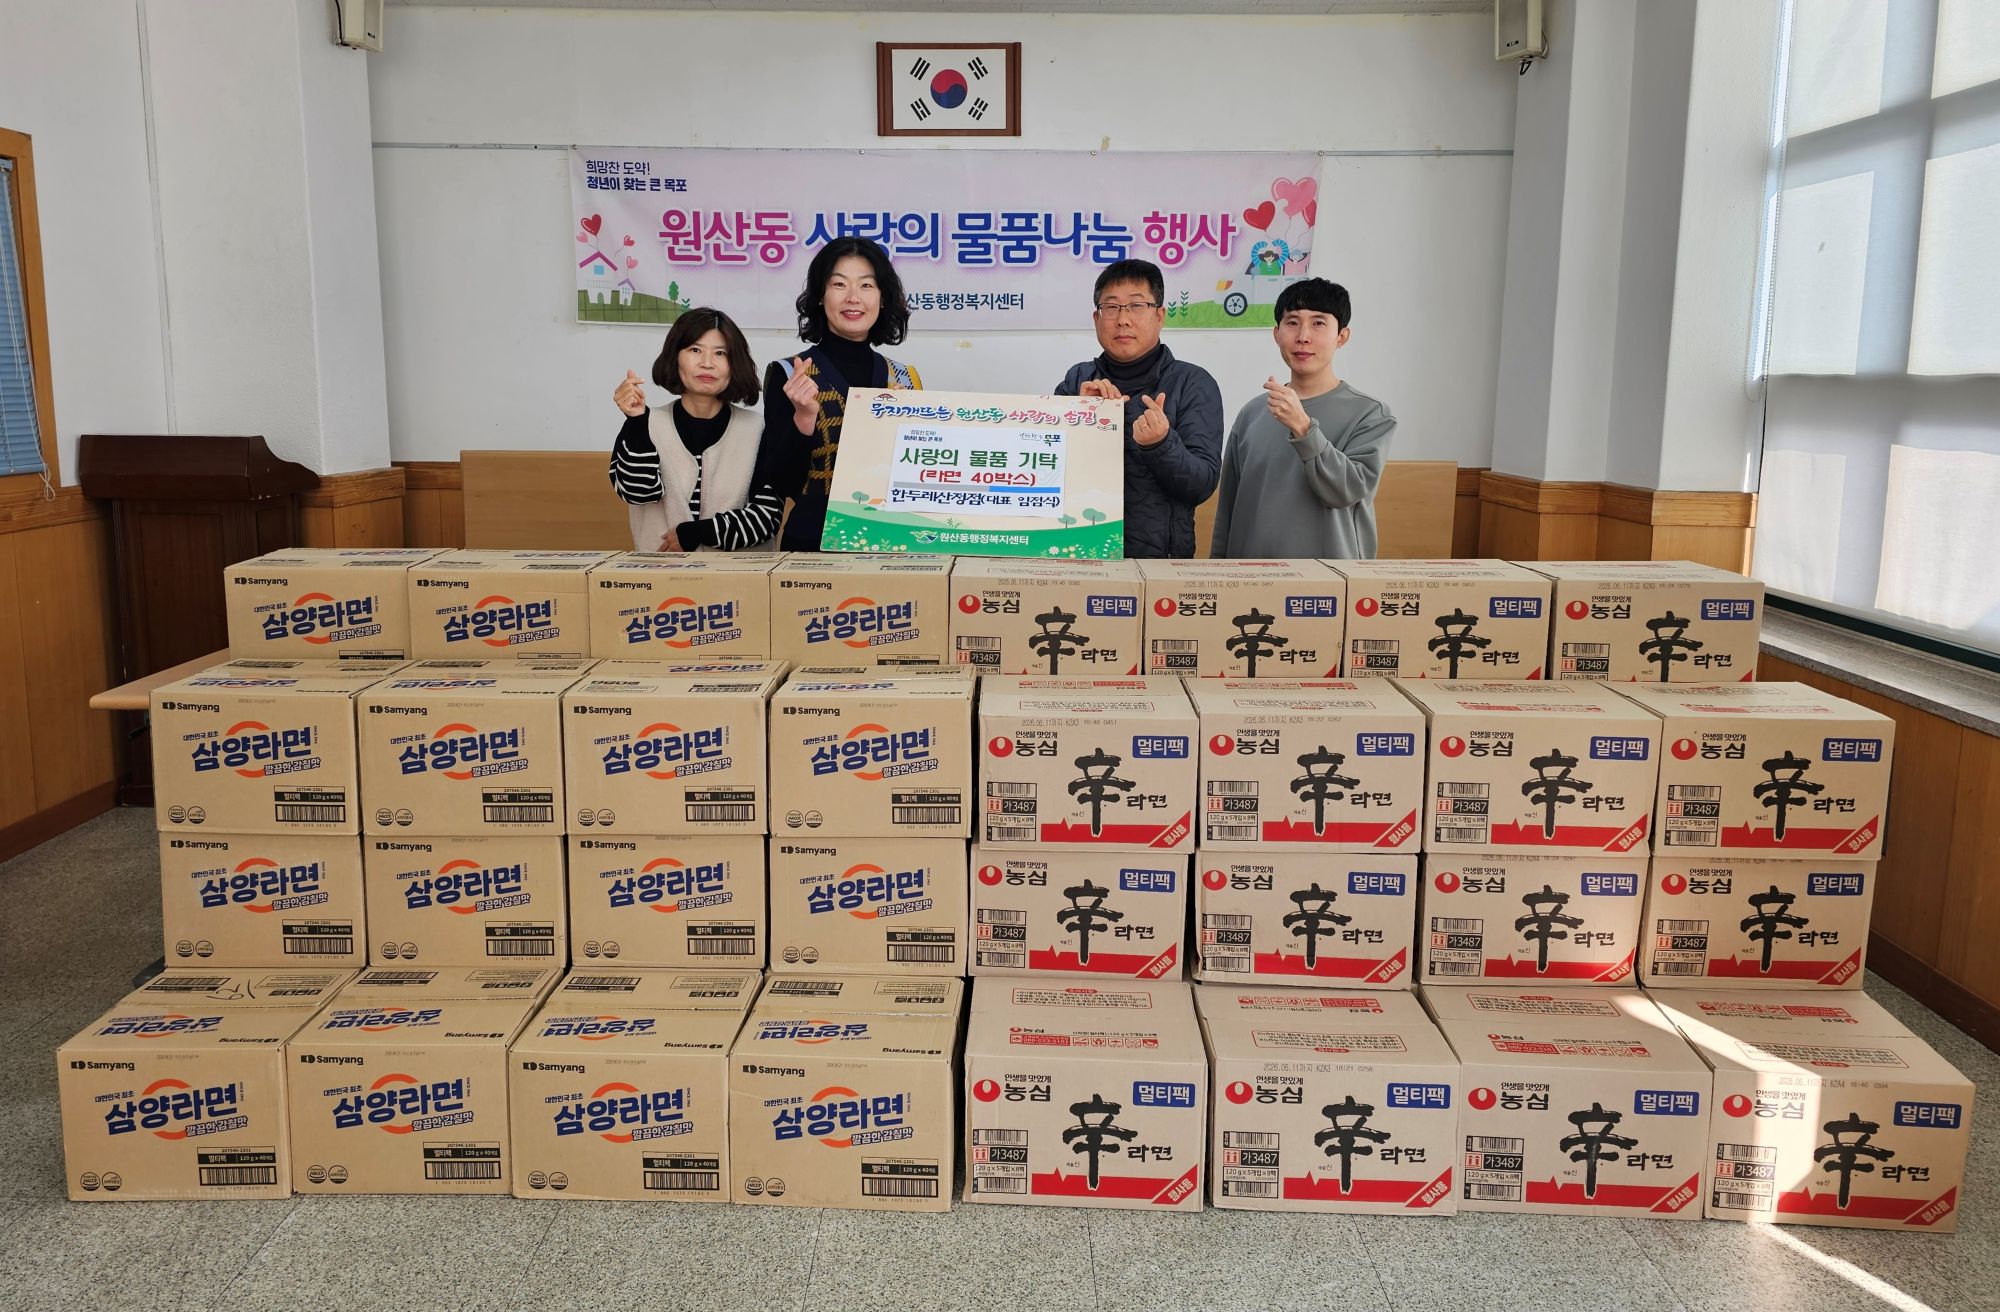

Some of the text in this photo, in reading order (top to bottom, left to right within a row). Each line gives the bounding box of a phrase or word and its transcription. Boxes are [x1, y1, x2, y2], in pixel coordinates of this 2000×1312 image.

[586, 160, 650, 175] 희망찬 도약!
[586, 176, 687, 192] 청년이 찾는 큰 목포
[659, 210, 1236, 265] 원산동 사랑의 물품나눔 행사
[907, 292, 1024, 310] 산동행정복지센터
[870, 403, 1096, 425] 무지개뜨는 원산동 사랑의 손길
[900, 447, 1058, 470] 사랑의 물품 기탁
[920, 469, 1036, 486] (라면 40박스)
[939, 531, 1029, 546] 원산동행정복지센터
[248, 578, 288, 586] Samyang
[430, 580, 469, 588] Samyang
[613, 582, 652, 590] Samyang
[793, 582, 832, 590] Samyang
[983, 598, 1020, 613] 농심
[1091, 599, 1133, 614] 멀티팩
[1179, 601, 1216, 616] 농심
[1290, 599, 1333, 614] 멀티팩
[1380, 601, 1419, 616] 농심
[1493, 600, 1538, 616] 멀티팩
[1591, 604, 1630, 619] 농심
[1705, 602, 1750, 618] 멀티팩
[262, 596, 372, 640] 삼양라면
[443, 600, 551, 642] 삼양라면
[626, 601, 733, 644] 삼양라면
[805, 601, 911, 643] 삼양라면
[972, 654, 999, 662] 가3487
[1168, 657, 1196, 666] 가3487
[1368, 657, 1396, 666] 가3487
[1578, 661, 1607, 670] 가3487
[177, 703, 220, 712] Samyang
[384, 707, 427, 715] Samyang
[588, 707, 632, 715] Samyang
[798, 707, 840, 716] Samyang
[191, 726, 311, 772] 삼양라면
[399, 728, 518, 774] 삼양라면
[602, 727, 722, 775] 삼양라면
[811, 728, 929, 776] 삼양라면
[1016, 740, 1057, 756] 농심
[1137, 739, 1184, 756] 멀티팩
[1237, 738, 1279, 754] 농심
[1361, 736, 1409, 753] 멀티팩
[1469, 740, 1512, 756] 농심
[1595, 740, 1644, 757] 멀티팩
[1701, 742, 1745, 759] 농심
[1827, 742, 1877, 759] 멀티팩
[1068, 747, 1167, 837] 辛 라면
[1290, 744, 1392, 835] 辛 라면
[1520, 748, 1625, 838] 辛 라면
[1750, 750, 1856, 841] 辛 라면
[1004, 802, 1035, 811] 가3487
[1225, 800, 1256, 810] 가3487
[1455, 802, 1487, 811] 가3487
[1685, 805, 1718, 815] 가3487
[185, 842, 228, 850] Samyang
[390, 843, 432, 852] Samyang
[594, 842, 636, 850] Samyang
[795, 847, 836, 856] Samyang
[199, 863, 319, 907] 삼양라면
[608, 862, 723, 908] 삼양라면
[1006, 869, 1046, 886] 농심
[1125, 872, 1170, 890] 멀티팩
[1231, 874, 1272, 890] 농심
[1353, 875, 1401, 893] 멀티팩
[1462, 876, 1505, 892] 농심
[1586, 877, 1633, 894] 멀티팩
[1812, 877, 1860, 893] 멀티팩
[404, 863, 521, 909] 삼양라면
[808, 869, 923, 914] 삼양라면
[1689, 878, 1732, 894] 농심
[994, 928, 1024, 937] 가3487
[1219, 933, 1249, 942] 가3487
[1449, 937, 1480, 946] 가3487
[1674, 938, 1705, 948] 가3487
[87, 1062, 135, 1070] Samyang
[316, 1056, 364, 1065] Samyang
[538, 1063, 585, 1073] Samyang
[758, 1066, 805, 1077] Samyang
[1028, 1075, 1051, 1083] 맛있게
[1280, 1077, 1303, 1085] 맛있게
[1501, 1082, 1550, 1091] 인생을 맛있게
[1004, 1083, 1050, 1102] 농심
[1138, 1085, 1190, 1104] 멀티팩
[1256, 1086, 1302, 1104] 농심
[1392, 1086, 1445, 1106] 멀티팩
[1756, 1090, 1807, 1100] 인생을 맛있게
[104, 1083, 237, 1135] 삼양라면
[332, 1078, 463, 1128] 삼양라면
[1500, 1092, 1548, 1110] 농심
[1640, 1094, 1694, 1113] 멀티팩
[1754, 1099, 1805, 1119] 농심
[554, 1089, 683, 1136] 삼양라면
[772, 1093, 903, 1140] 삼양라면
[1899, 1105, 1956, 1126] 멀티팩
[186, 1116, 248, 1137] 깔끔한 감칠맛
[412, 1111, 474, 1132] 깔끔한 감칠맛
[632, 1122, 693, 1141] 깔끔한 감칠맛
[852, 1127, 913, 1146] 깔끔한 감칠맛
[1063, 1094, 1172, 1189] 辛 라면
[1314, 1095, 1426, 1193] 辛 라면
[1558, 1102, 1673, 1197] 辛 라면
[992, 1150, 1025, 1160] 가3487
[1243, 1153, 1277, 1164] 가3487
[1486, 1158, 1521, 1168] 가3487
[1809, 1111, 1931, 1209] 辛 라면
[1736, 1166, 1773, 1177] 가3487
[1167, 1178, 1194, 1202] 행사용
[1421, 1181, 1448, 1205] 행사용
[1667, 1187, 1694, 1210] 행사용
[1921, 1200, 1951, 1223] 행사용
